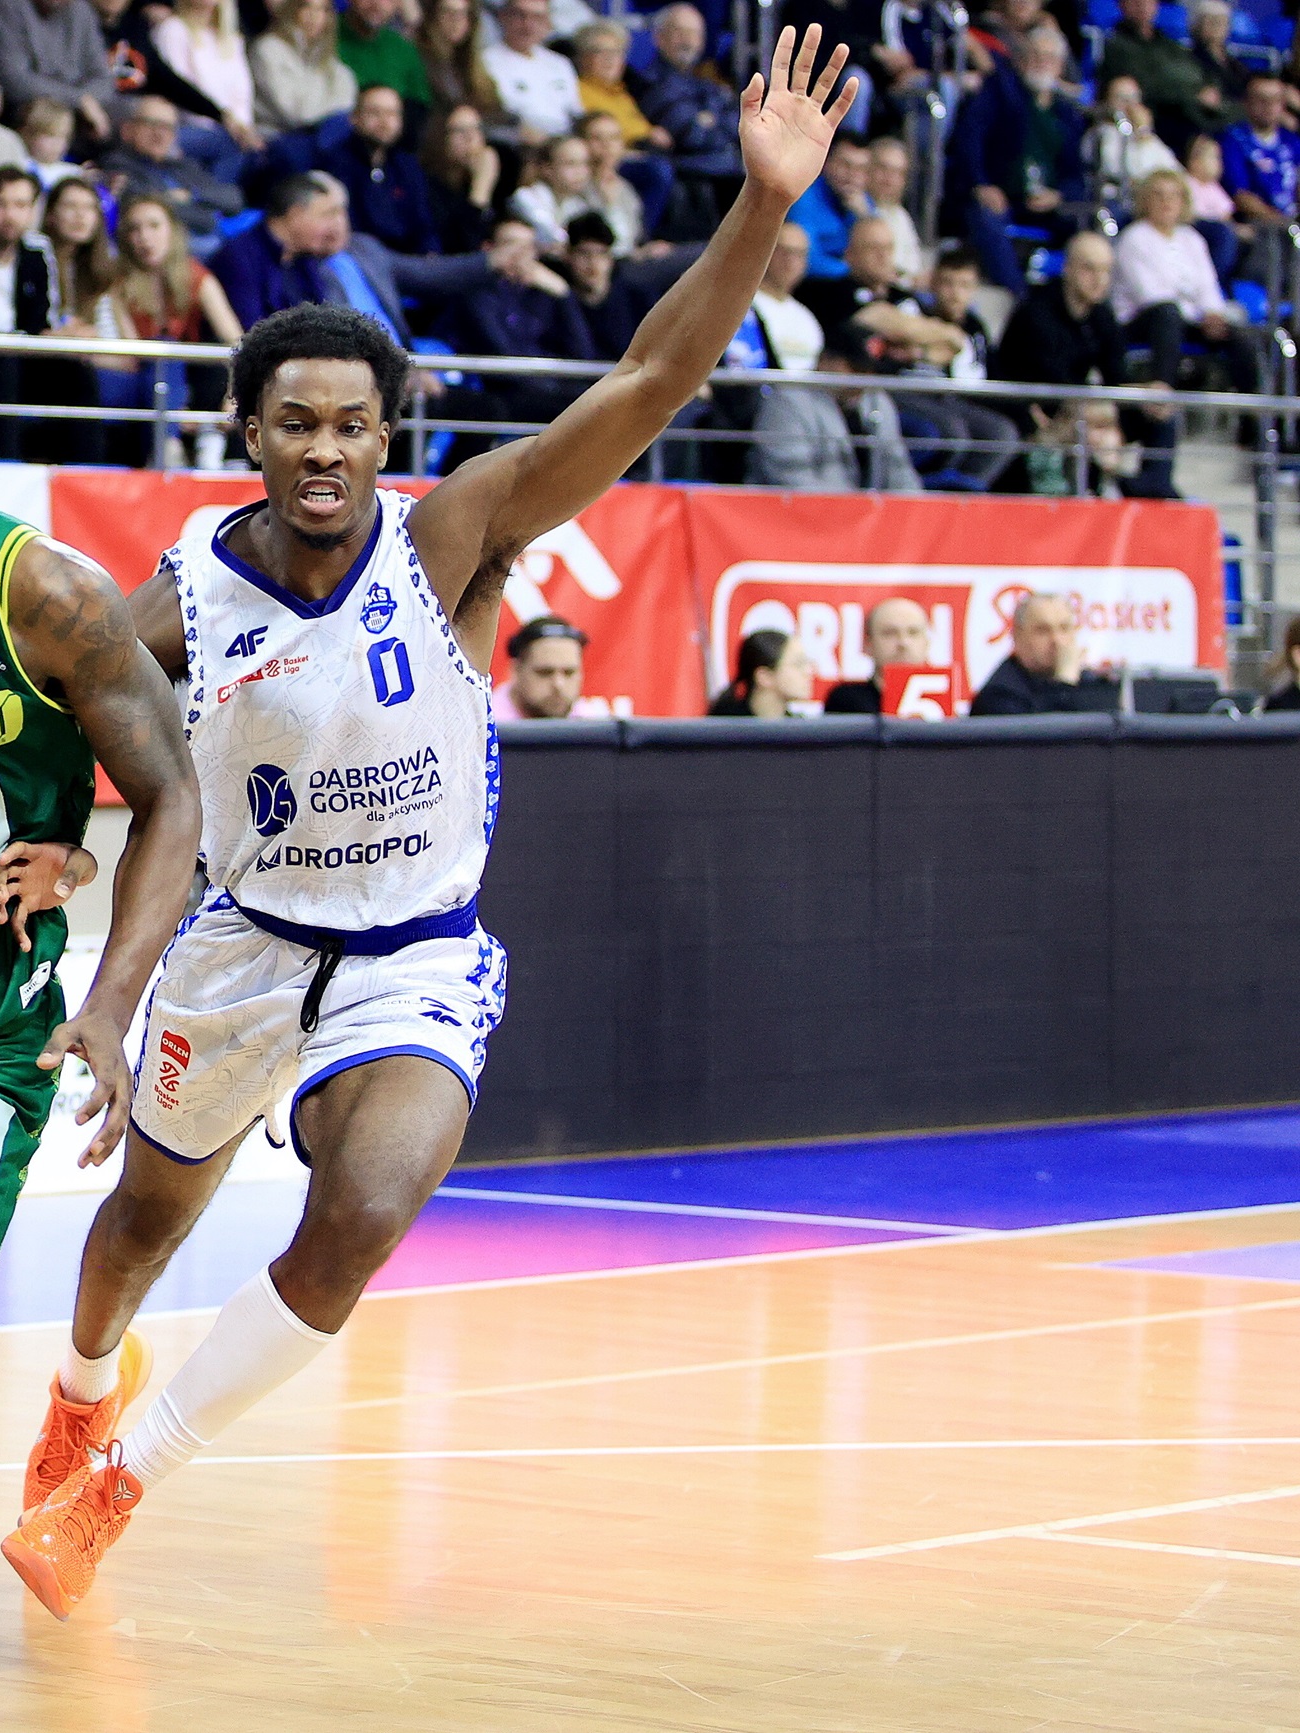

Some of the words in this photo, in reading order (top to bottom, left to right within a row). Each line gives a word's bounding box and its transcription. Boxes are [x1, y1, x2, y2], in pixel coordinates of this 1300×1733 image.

[224, 625, 269, 659] 4F
[739, 599, 953, 680] RLN
[283, 655, 309, 666] Basket
[283, 666, 300, 674] Liga
[365, 636, 415, 708] 0
[897, 674, 950, 722] 5
[366, 811, 385, 822] dla
[388, 793, 443, 820] aktywnych
[285, 829, 433, 869] DROGOPOL
[162, 1038, 190, 1059] ORLEN
[154, 1083, 180, 1107] Basket
[156, 1095, 173, 1110] Liga
